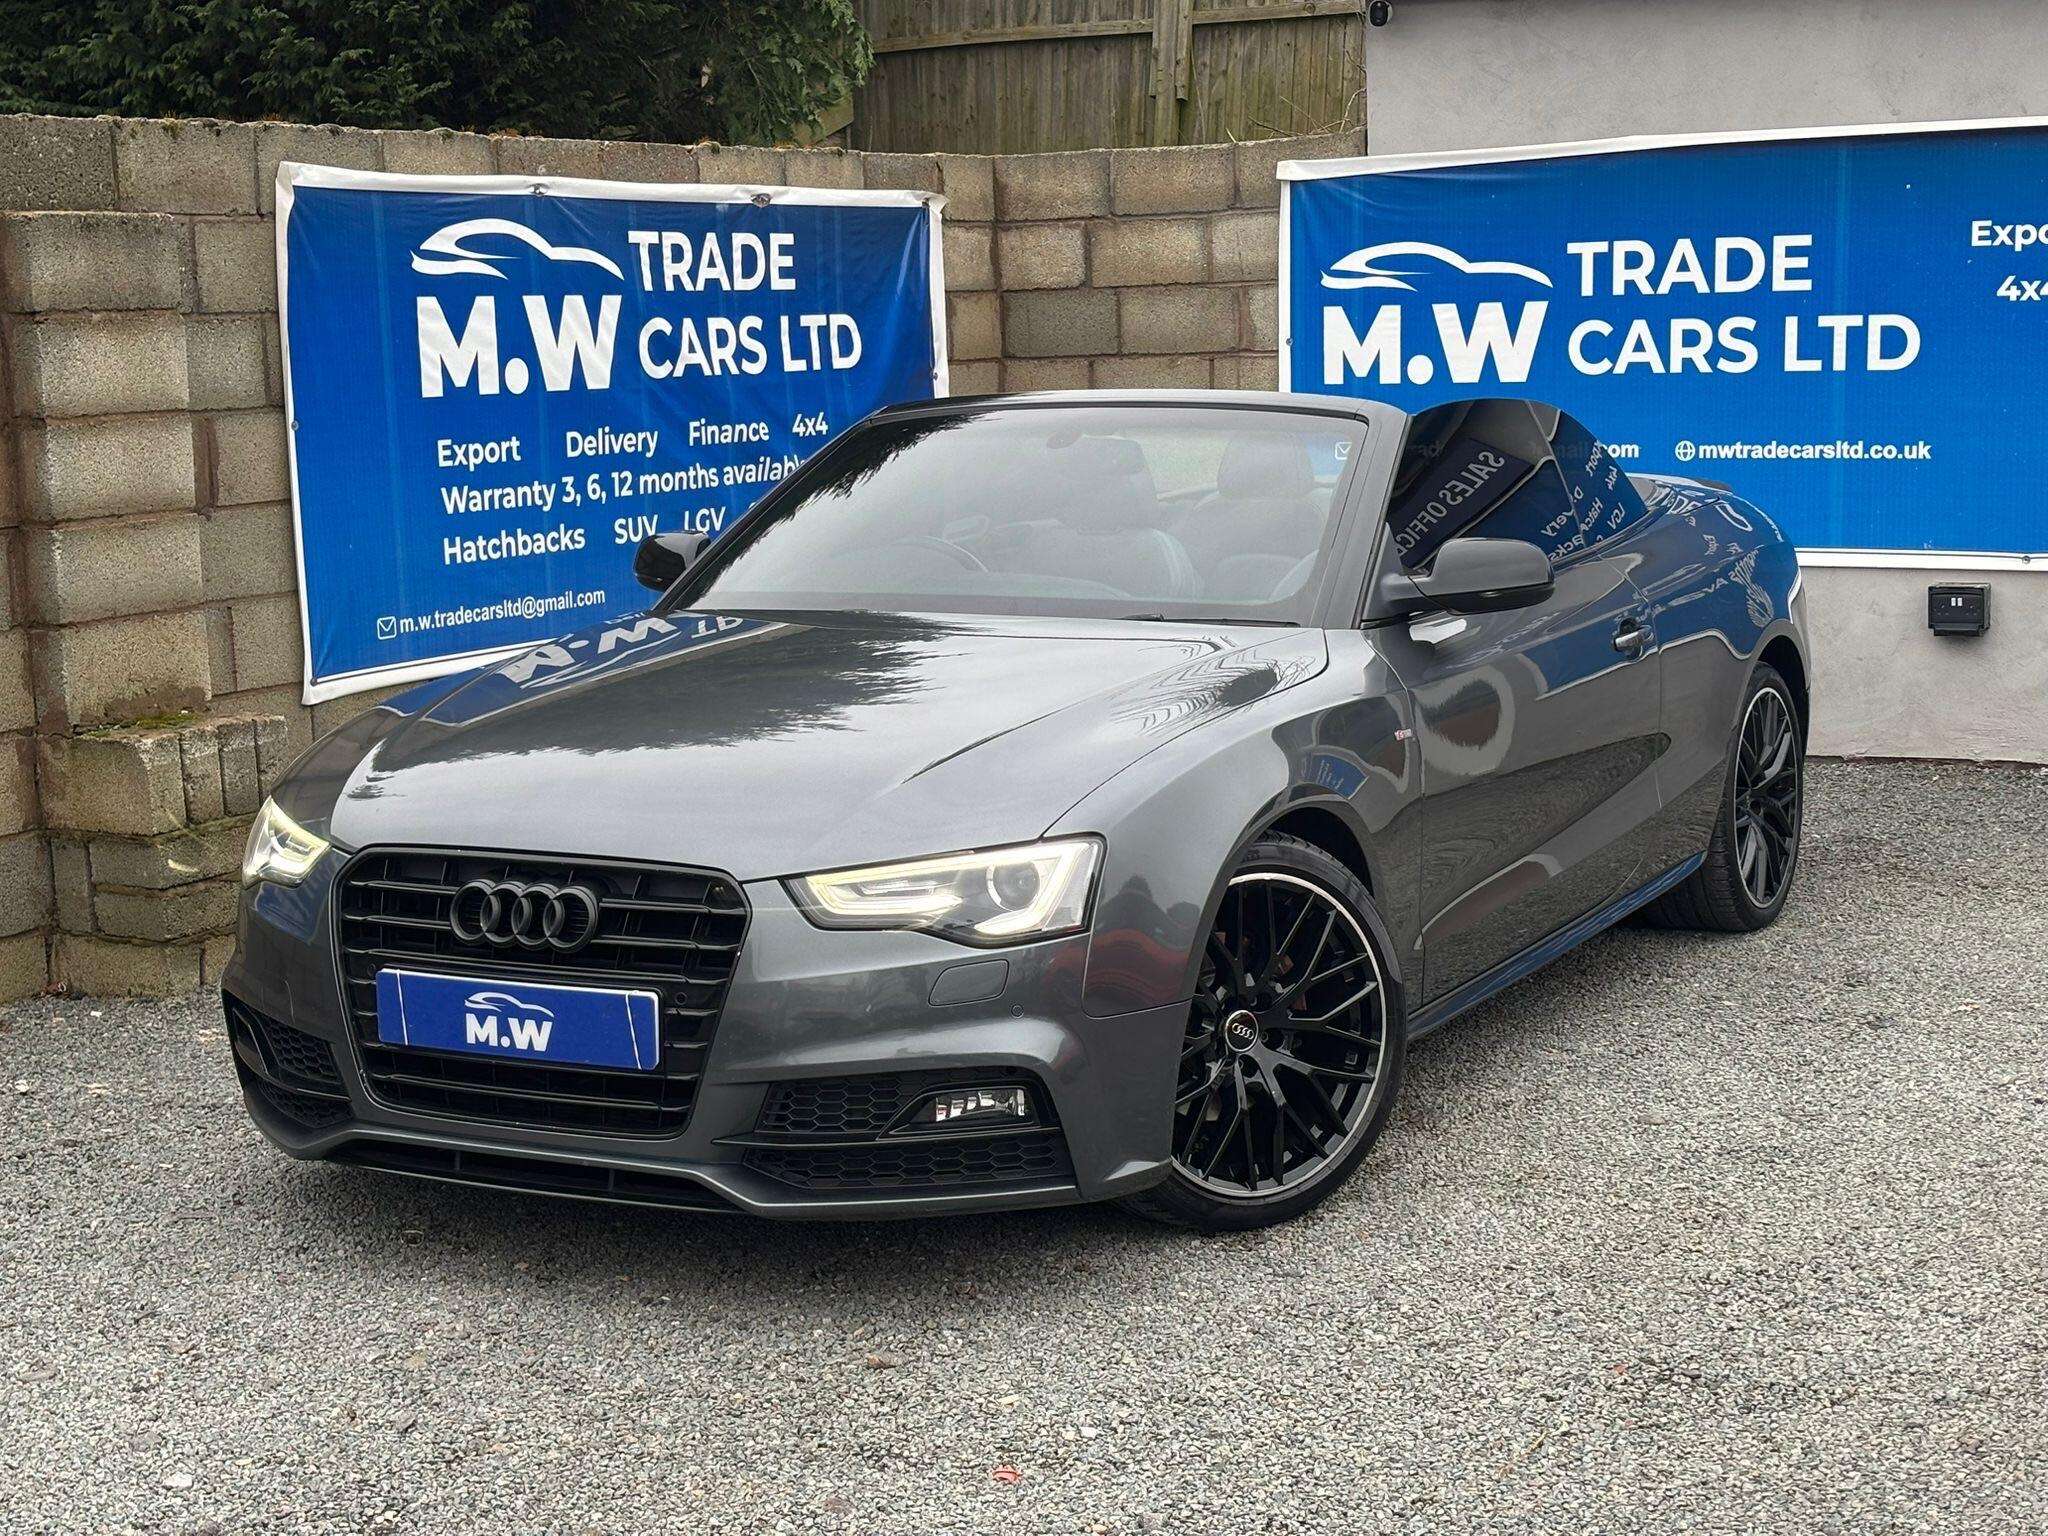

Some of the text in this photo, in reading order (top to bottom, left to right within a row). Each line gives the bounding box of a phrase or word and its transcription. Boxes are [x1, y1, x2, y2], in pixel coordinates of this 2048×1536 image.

[628, 231, 796, 292] TRADE
[1567, 235, 1813, 297] TRADE
[417, 294, 622, 398] M.W
[638, 313, 863, 379] CARS LTD
[1324, 300, 1549, 385] M.W
[1568, 314, 1921, 376] CARS LTD
[437, 411, 829, 472] Export Delivery Finance 4x4
[1699, 440, 1932, 460] mwtradecarsltd.co.uk
[441, 454, 804, 515] Warranty 3, 6, 12 months availabl
[444, 506, 727, 565] Hatchbacks SUV LGV
[400, 590, 606, 634] m.w.tradecarsltd@gmail.com
[465, 1012, 553, 1052] M.W
